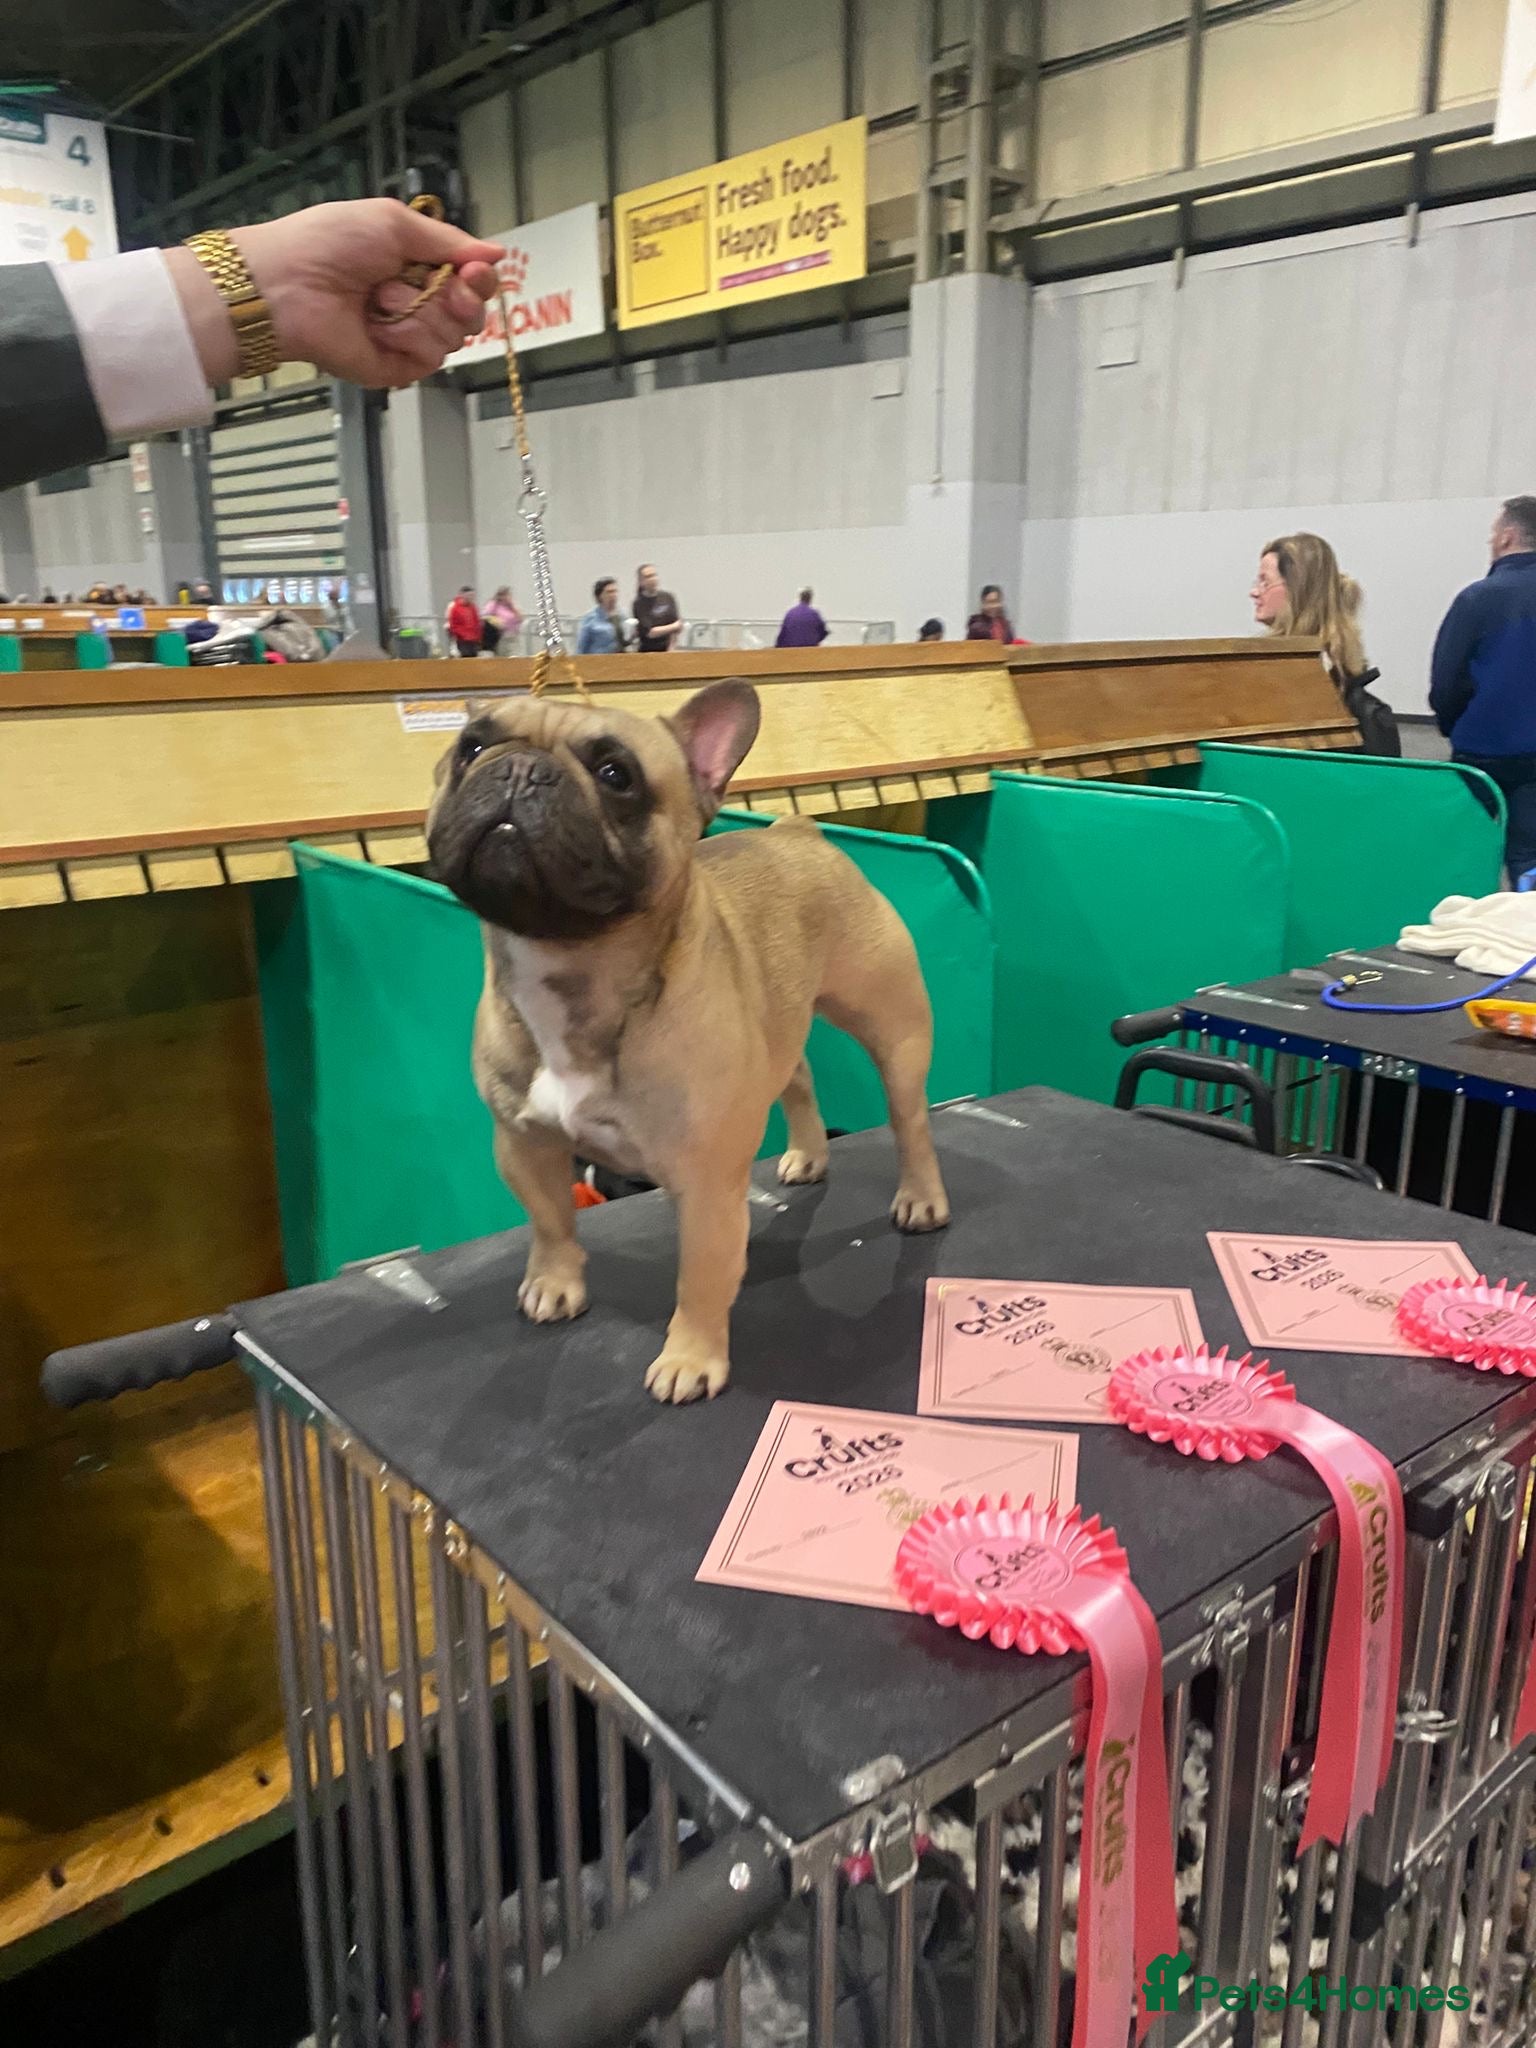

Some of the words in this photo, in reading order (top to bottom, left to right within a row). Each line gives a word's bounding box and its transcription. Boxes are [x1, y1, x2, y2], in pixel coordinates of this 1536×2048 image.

[66, 134, 91, 167] 4
[716, 167, 776, 217] Fresh
[782, 146, 839, 197] food.
[717, 217, 783, 262] Happy
[788, 201, 847, 243] dogs.
[1250, 1249, 1329, 1281] Crufts
[955, 1296, 1048, 1336] Crufts
[1172, 1380, 1231, 1412] Crufts
[784, 1432, 904, 1479] Crufts
[974, 1542, 1047, 1590] Crufts
[1368, 1505, 1389, 1625] Crufts
[1102, 1757, 1131, 1888] Crufts
